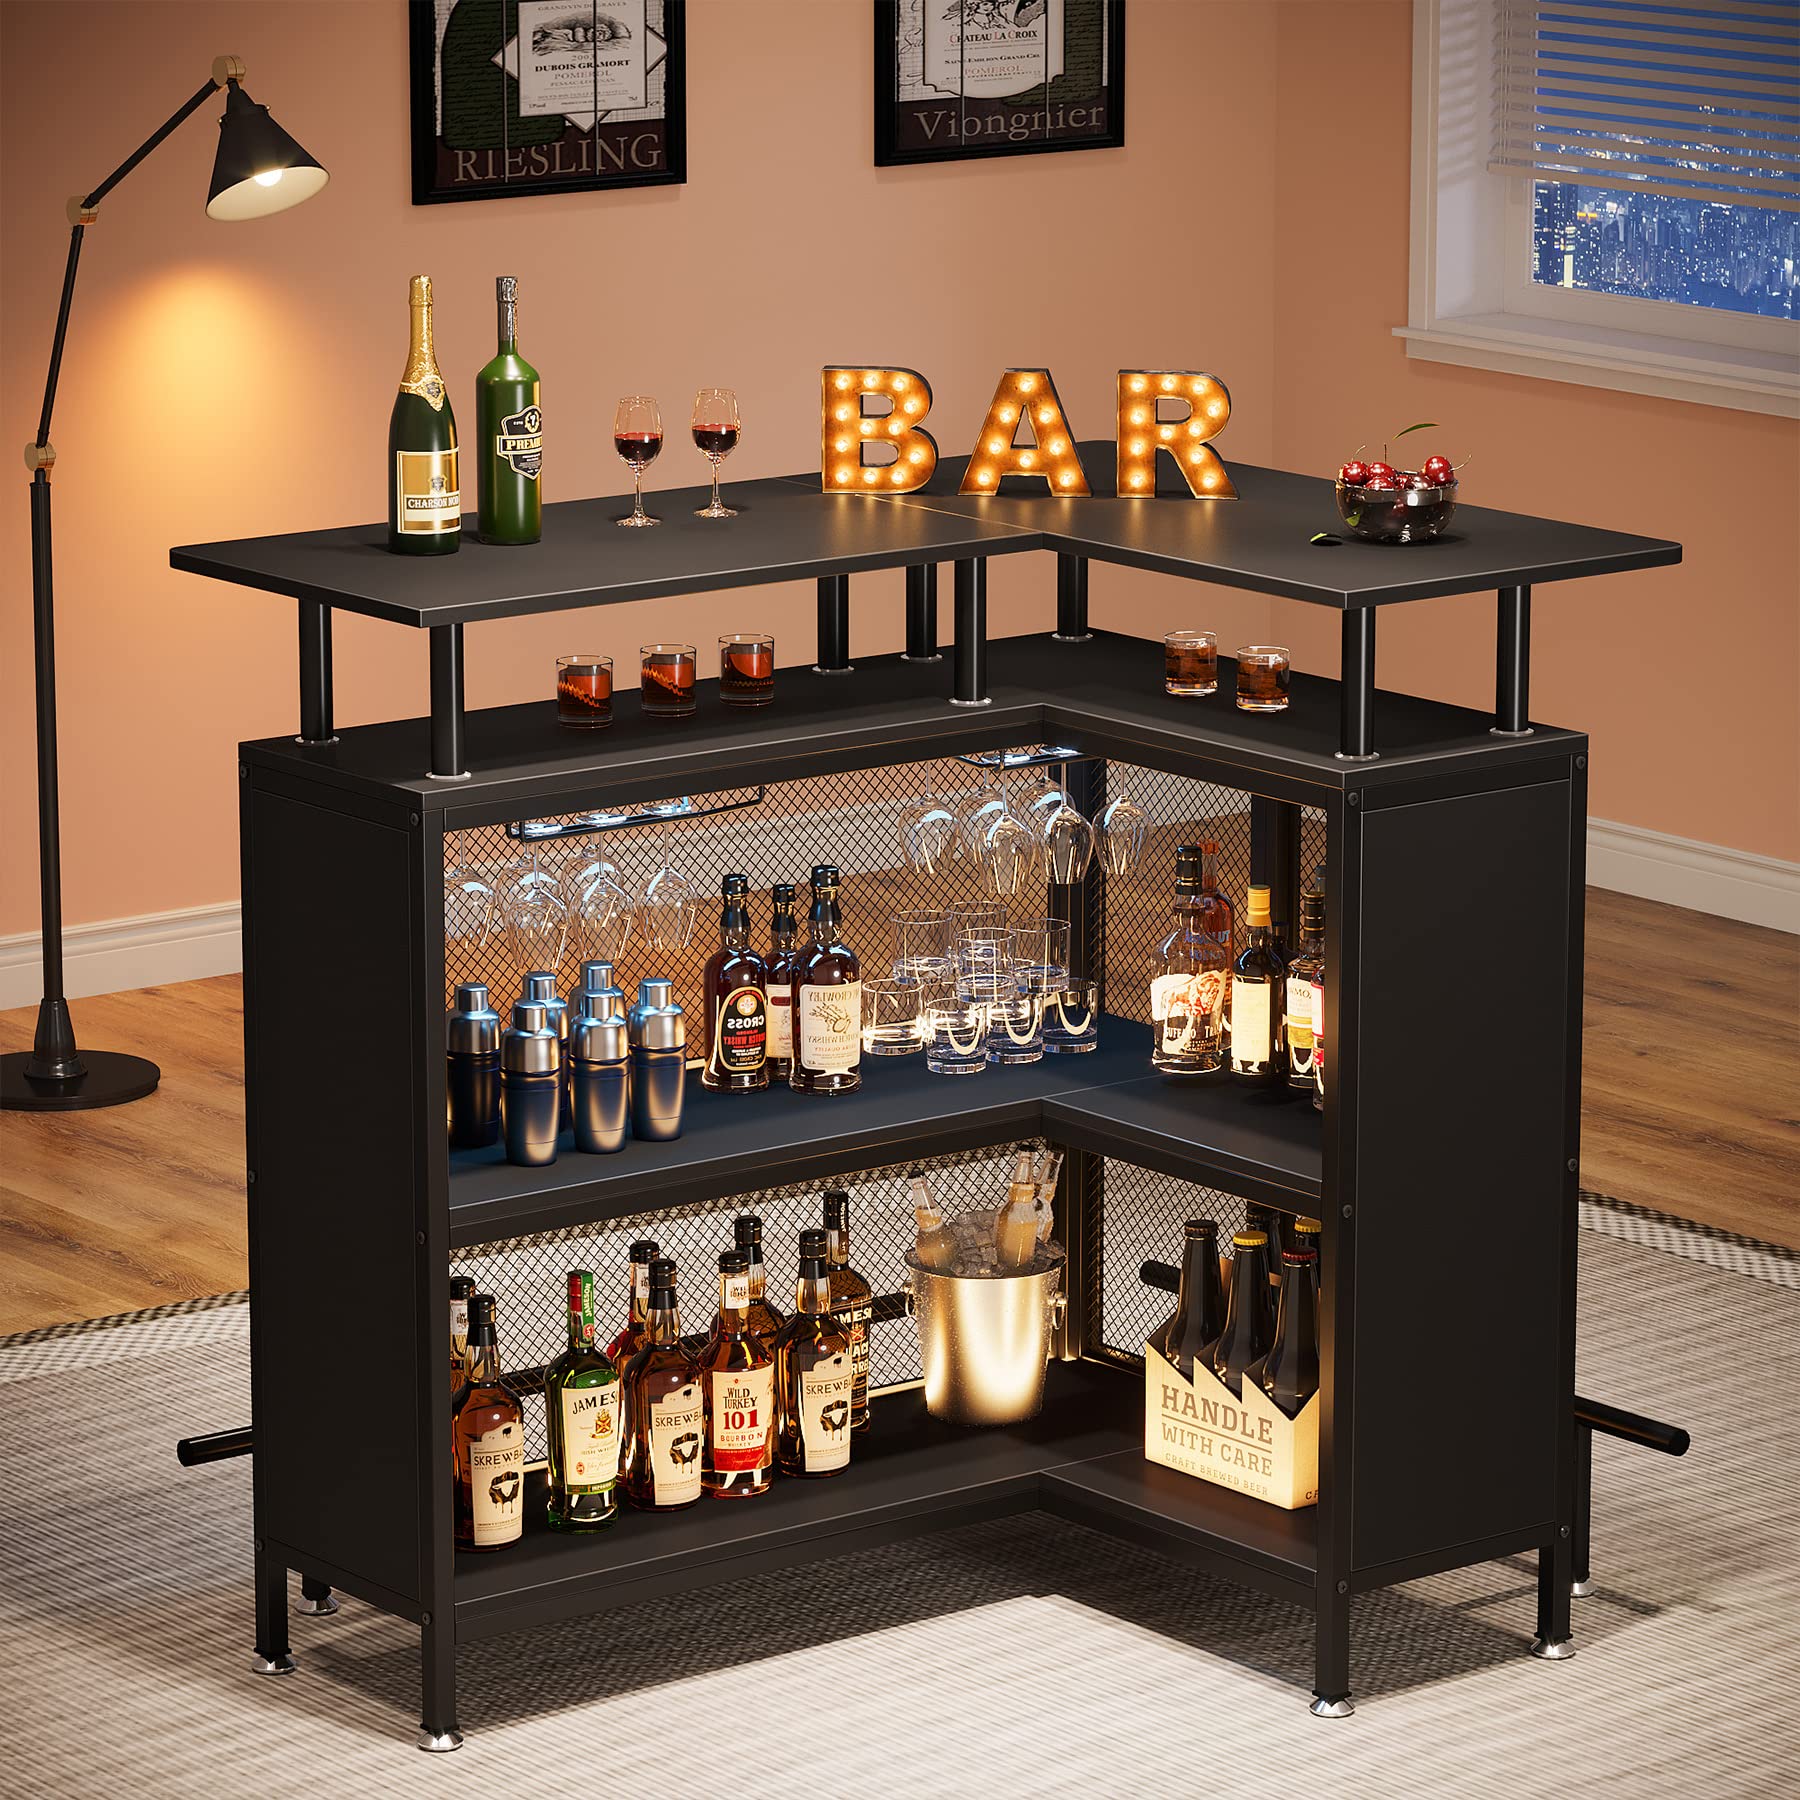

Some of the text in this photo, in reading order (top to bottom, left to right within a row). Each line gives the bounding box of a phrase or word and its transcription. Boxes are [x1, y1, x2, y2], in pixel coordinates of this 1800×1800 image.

[994, 31, 1006, 41] LA
[1007, 30, 1038, 40] CROIX
[535, 64, 577, 73] DUBOIS
[964, 66, 1024, 76] POMEROL
[914, 104, 1104, 141] Viongnier
[454, 133, 661, 182] RIESLING
[822, 365, 1239, 499] BAR
[583, 1283, 593, 1317] JAMESON
[723, 1396, 758, 1410] TURKEY
[727, 1387, 750, 1399] WILD
[723, 1409, 760, 1430] 101
[1162, 1383, 1273, 1445] HANDLE
[720, 1432, 763, 1442] BOURBON
[1161, 1422, 1272, 1477] WITH CARE
[1165, 1453, 1268, 1496] CRAFT BREWED BEER
